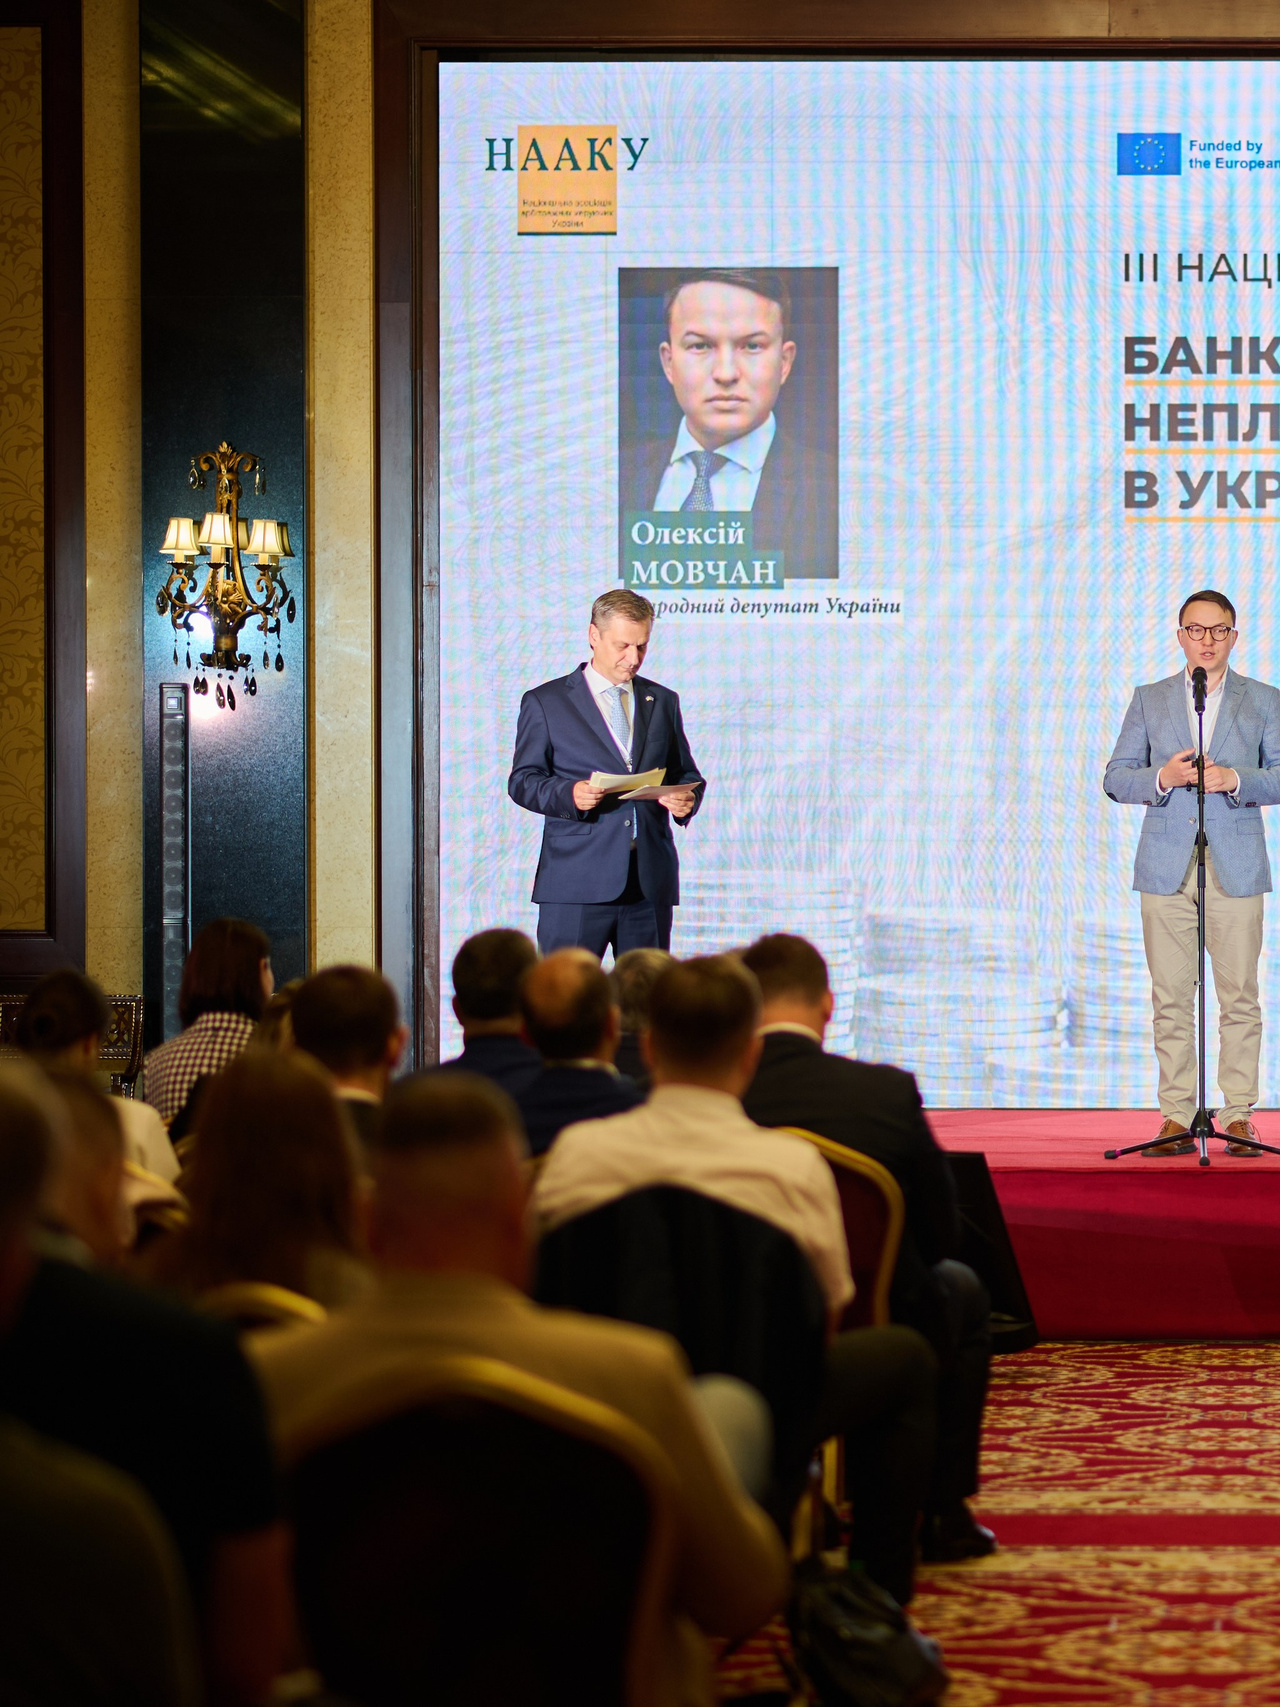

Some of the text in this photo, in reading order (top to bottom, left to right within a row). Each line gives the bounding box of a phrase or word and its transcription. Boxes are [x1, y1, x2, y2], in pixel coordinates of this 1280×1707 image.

[485, 137, 649, 171] НААКУ
[1189, 140, 1263, 154] Funded by
[1189, 158, 1211, 169] the
[1124, 470, 1160, 509] В
[631, 521, 746, 545] Олексій
[631, 560, 776, 585] МОВЧАН
[653, 597, 901, 620] родний депутат України
